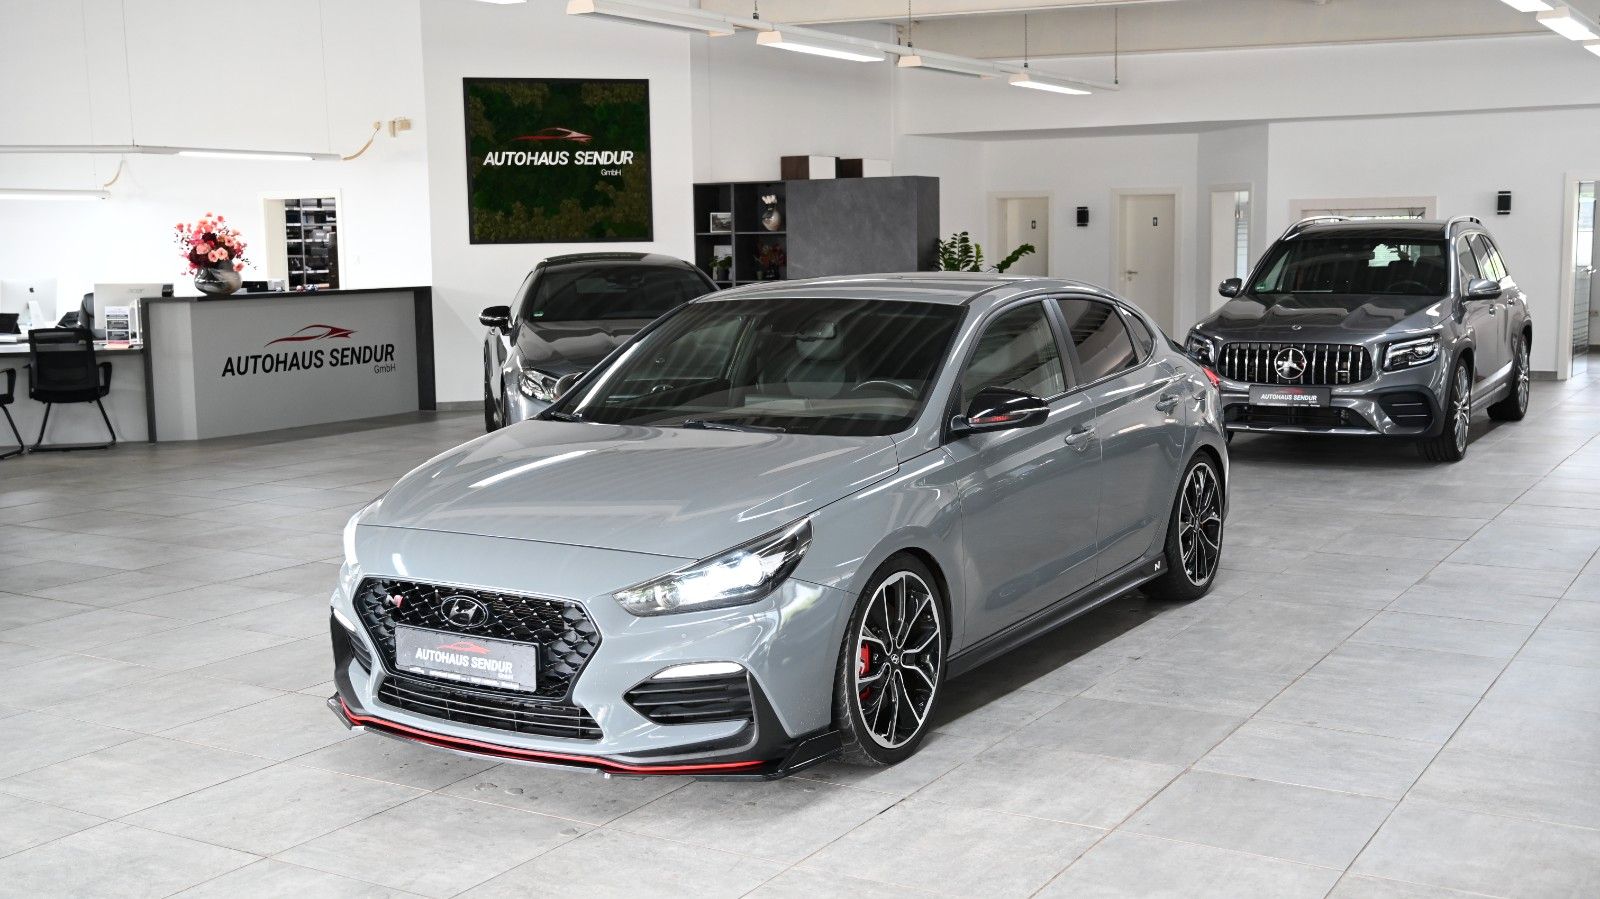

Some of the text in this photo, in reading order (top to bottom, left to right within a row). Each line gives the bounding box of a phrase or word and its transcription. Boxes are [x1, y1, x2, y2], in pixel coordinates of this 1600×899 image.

[483, 150, 634, 166] AUTOHAUS SENDUR
[600, 168, 622, 176] GmbH
[221, 343, 395, 377] AUTOHAUS SENDUR
[373, 364, 396, 374] GmbH
[1260, 393, 1293, 401] AUTOHAUS
[415, 647, 513, 674] AUTOHAUS SENDUR
